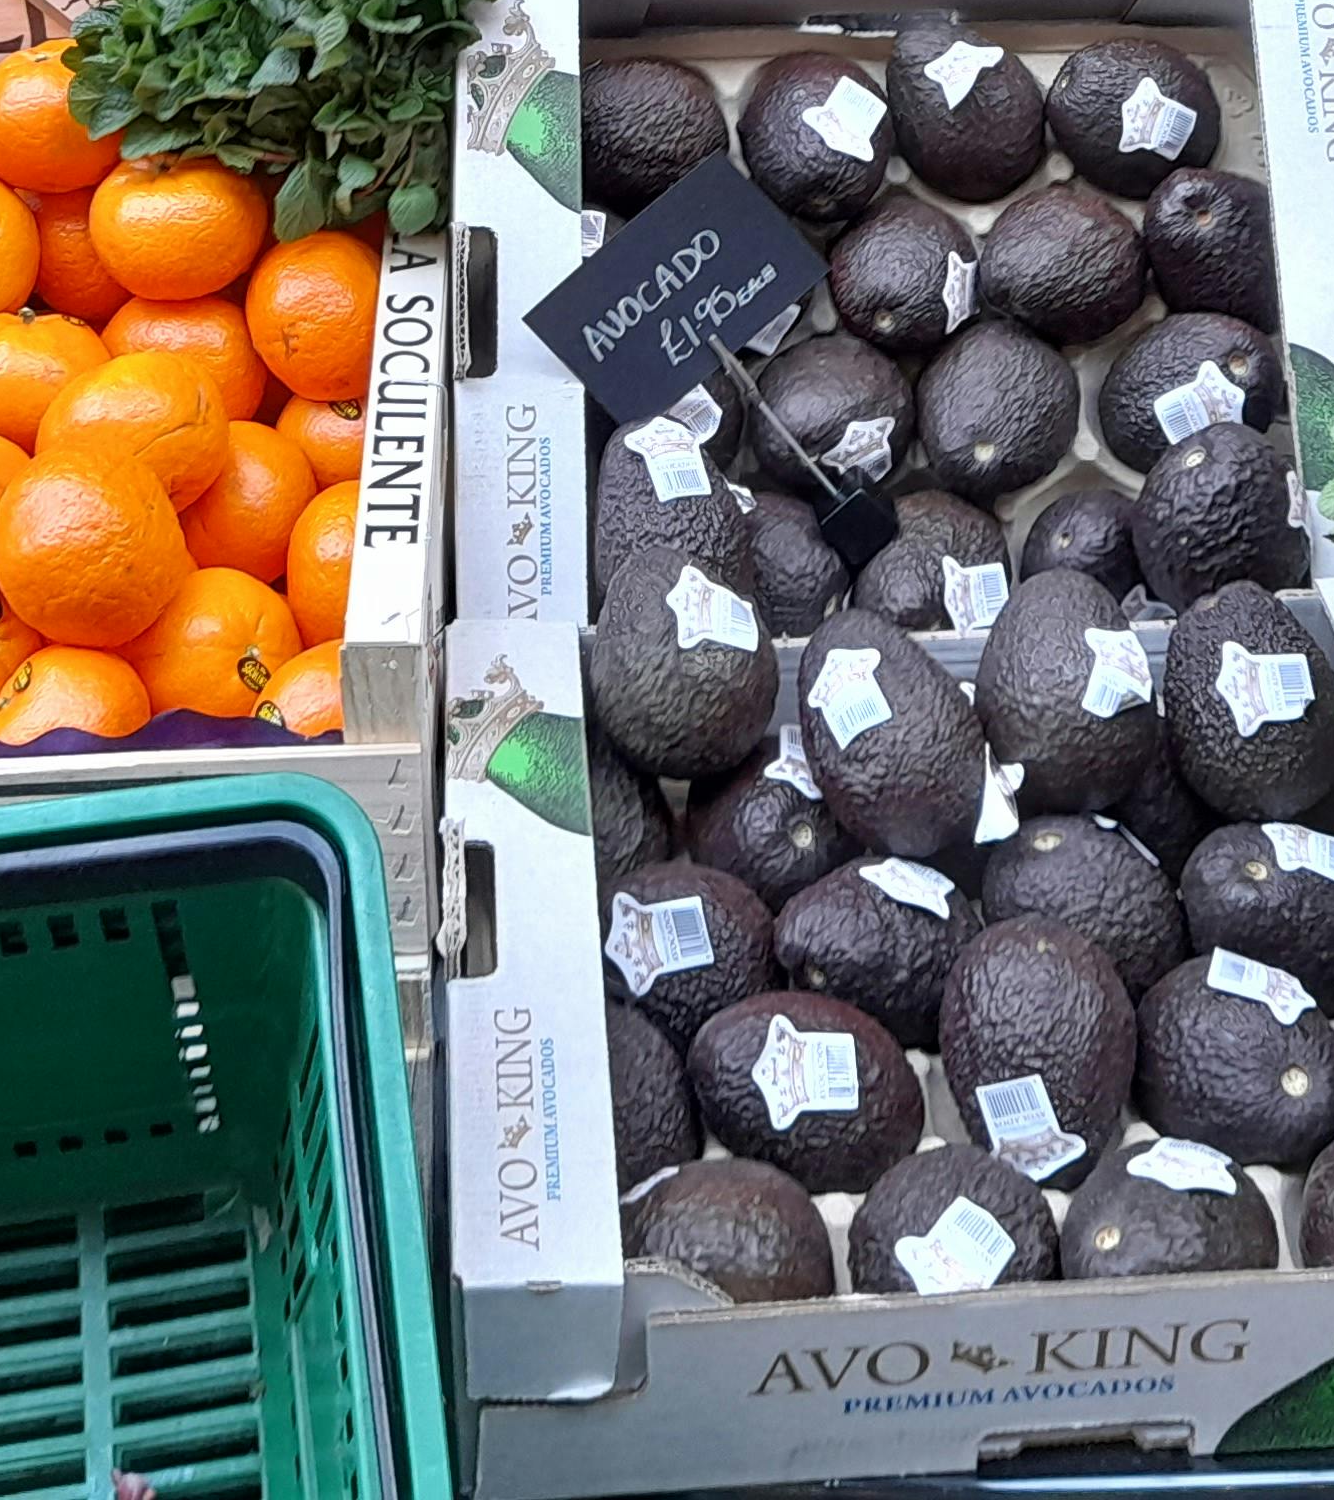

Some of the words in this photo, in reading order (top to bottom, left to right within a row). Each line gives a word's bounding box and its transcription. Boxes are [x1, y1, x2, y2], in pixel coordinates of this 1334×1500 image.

[1301, 58, 1320, 134] AVOCADOS
[582, 229, 720, 363] AVOCADO
[365, 293, 435, 548] SOCULENTE
[506, 404, 538, 508] KING
[539, 437, 553, 526] AVOCADOS
[539, 528, 554, 596] PREMIUM
[494, 1006, 534, 1113] KING
[542, 1038, 557, 1134] AVOCADOS
[501, 1160, 541, 1252] AVO
[547, 1135, 561, 1201] PREMIUM
[748, 1339, 931, 1398] AVO
[1034, 1318, 1252, 1377] KING
[844, 1386, 996, 1416] PREMIUM
[1002, 1375, 1175, 1407] AVOCADOS
